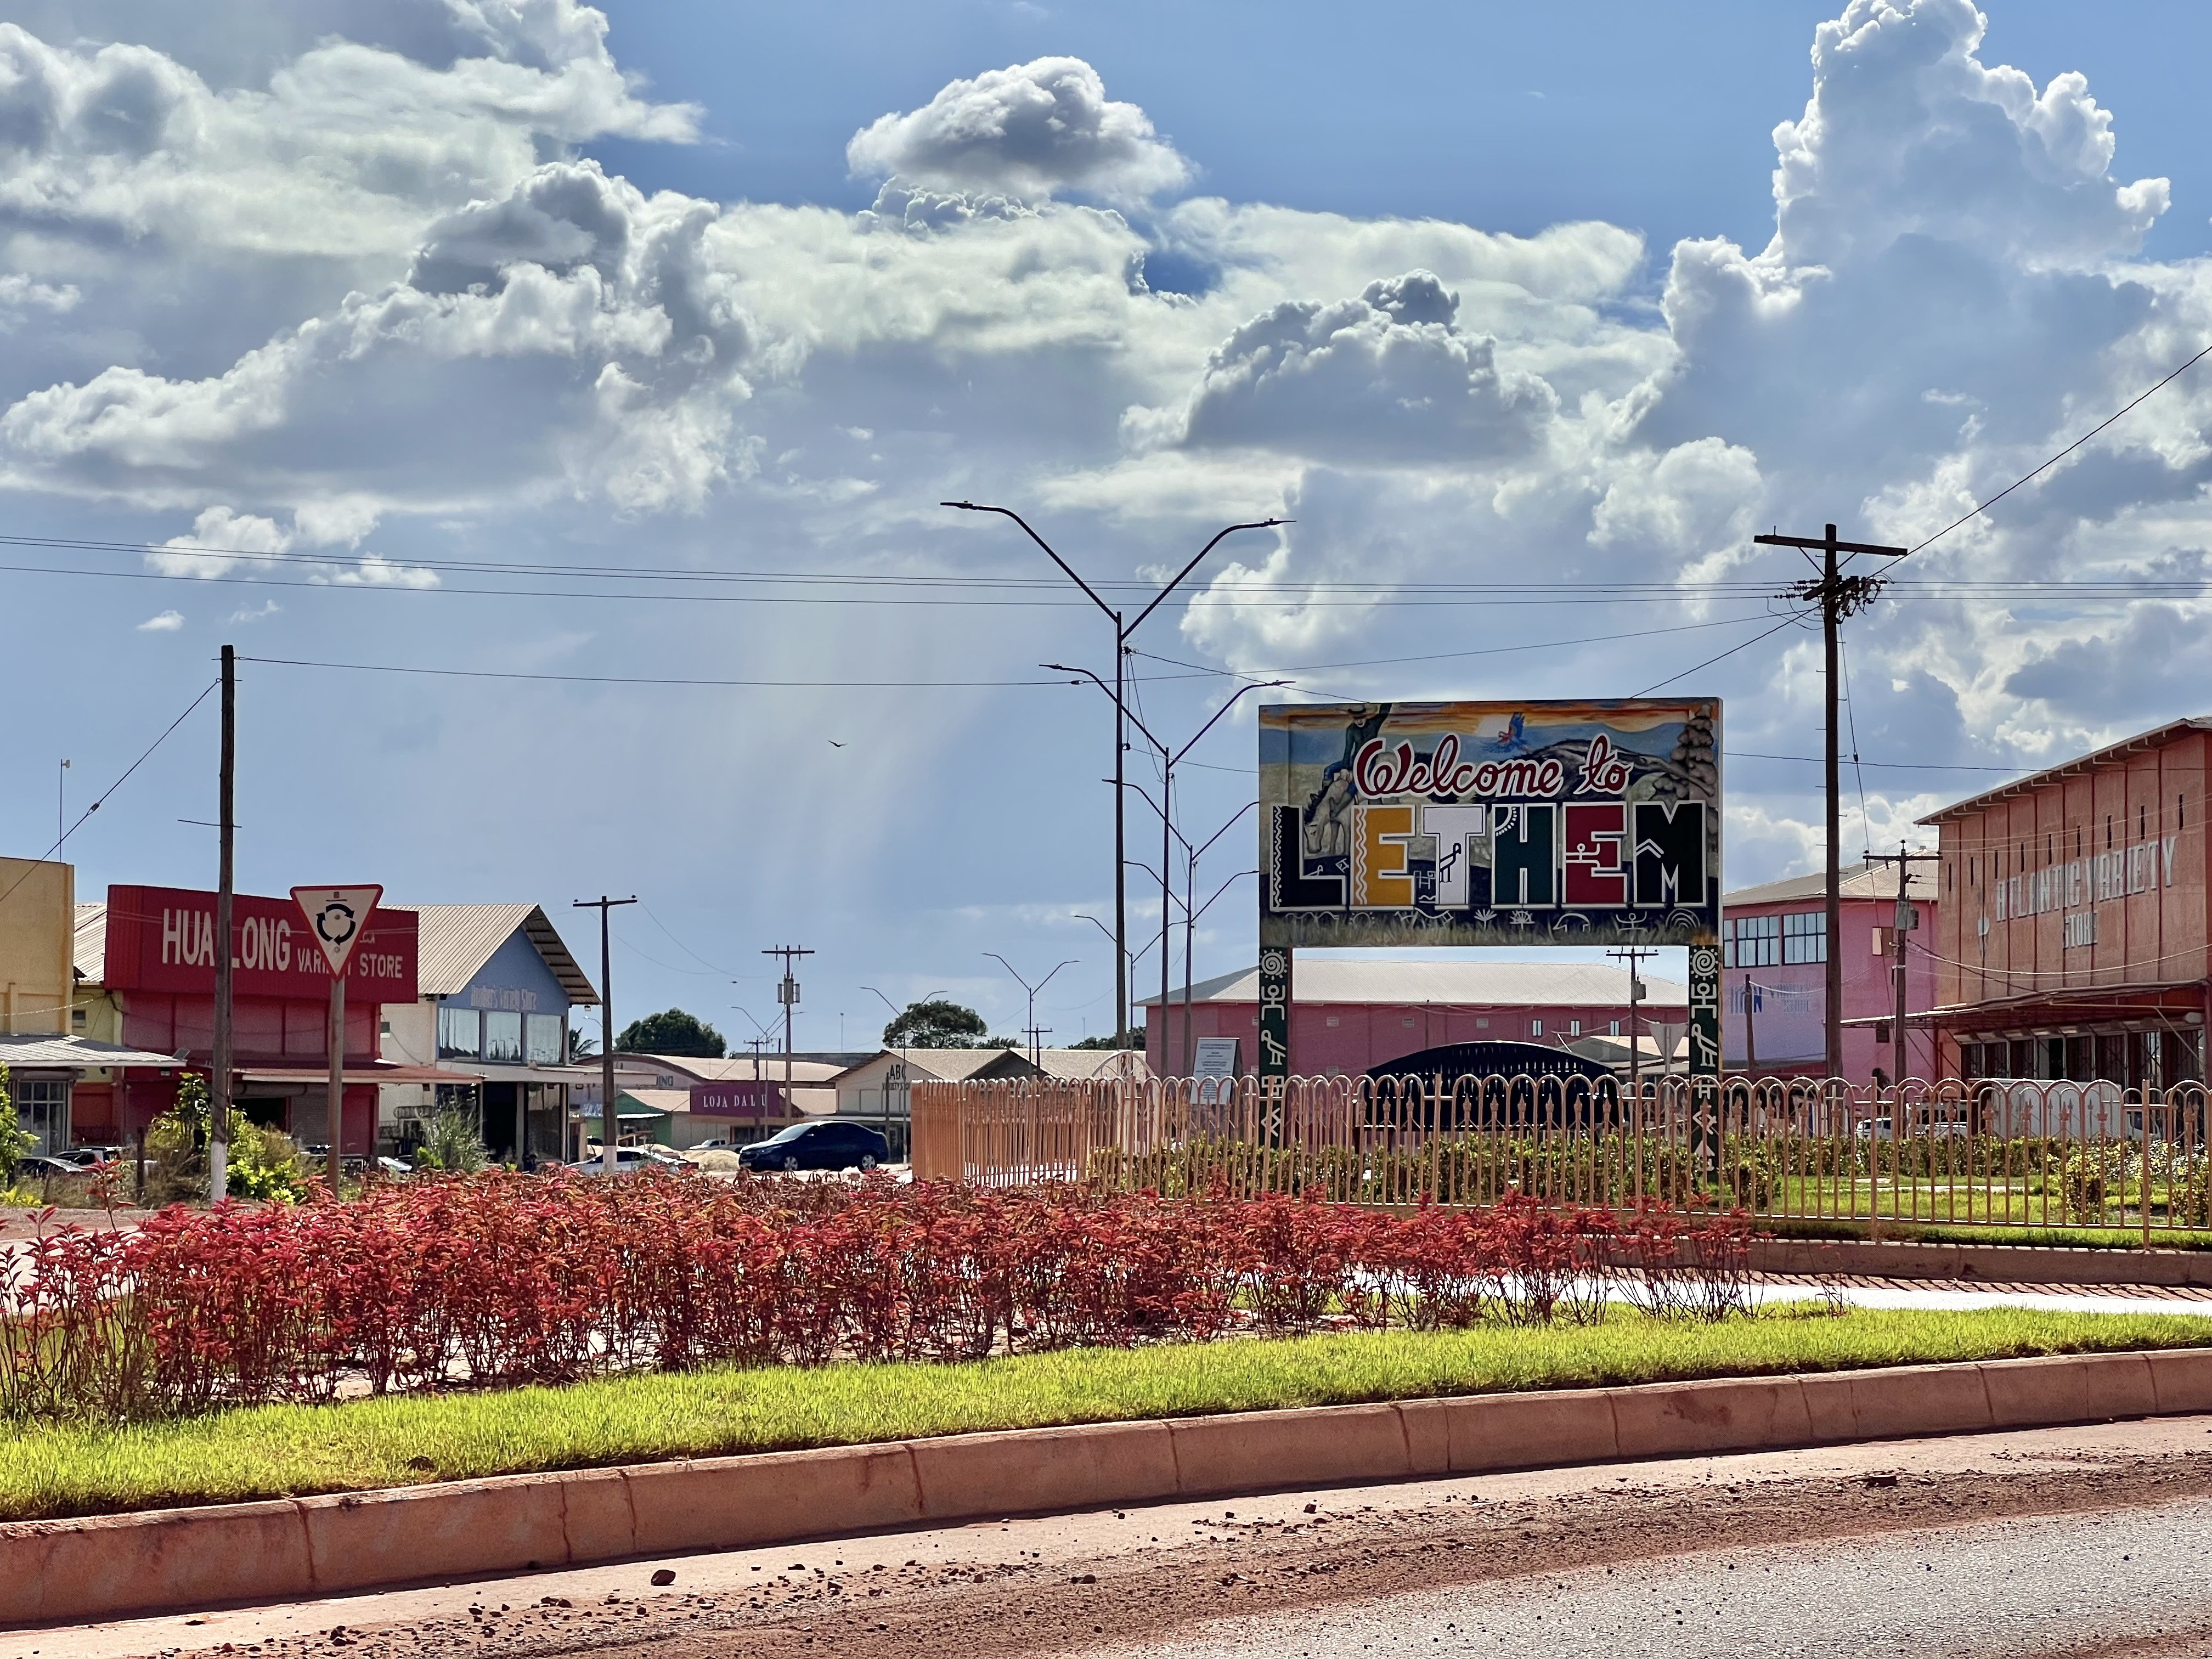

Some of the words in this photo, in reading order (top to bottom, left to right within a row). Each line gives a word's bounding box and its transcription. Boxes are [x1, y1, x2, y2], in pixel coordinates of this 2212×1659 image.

[1353, 733, 1564, 798] Welcome
[1572, 733, 1634, 795] to
[1270, 799, 1707, 912] LETHEM
[1996, 860, 2081, 922] ATLANTIC
[2085, 836, 2177, 903] VARIETY
[162, 908, 215, 967] HUA
[230, 916, 291, 972] ONG
[359, 952, 403, 978] STORE
[656, 1075, 674, 1087] ING
[890, 1064, 907, 1080] ABC
[703, 1096, 727, 1108] LOJA
